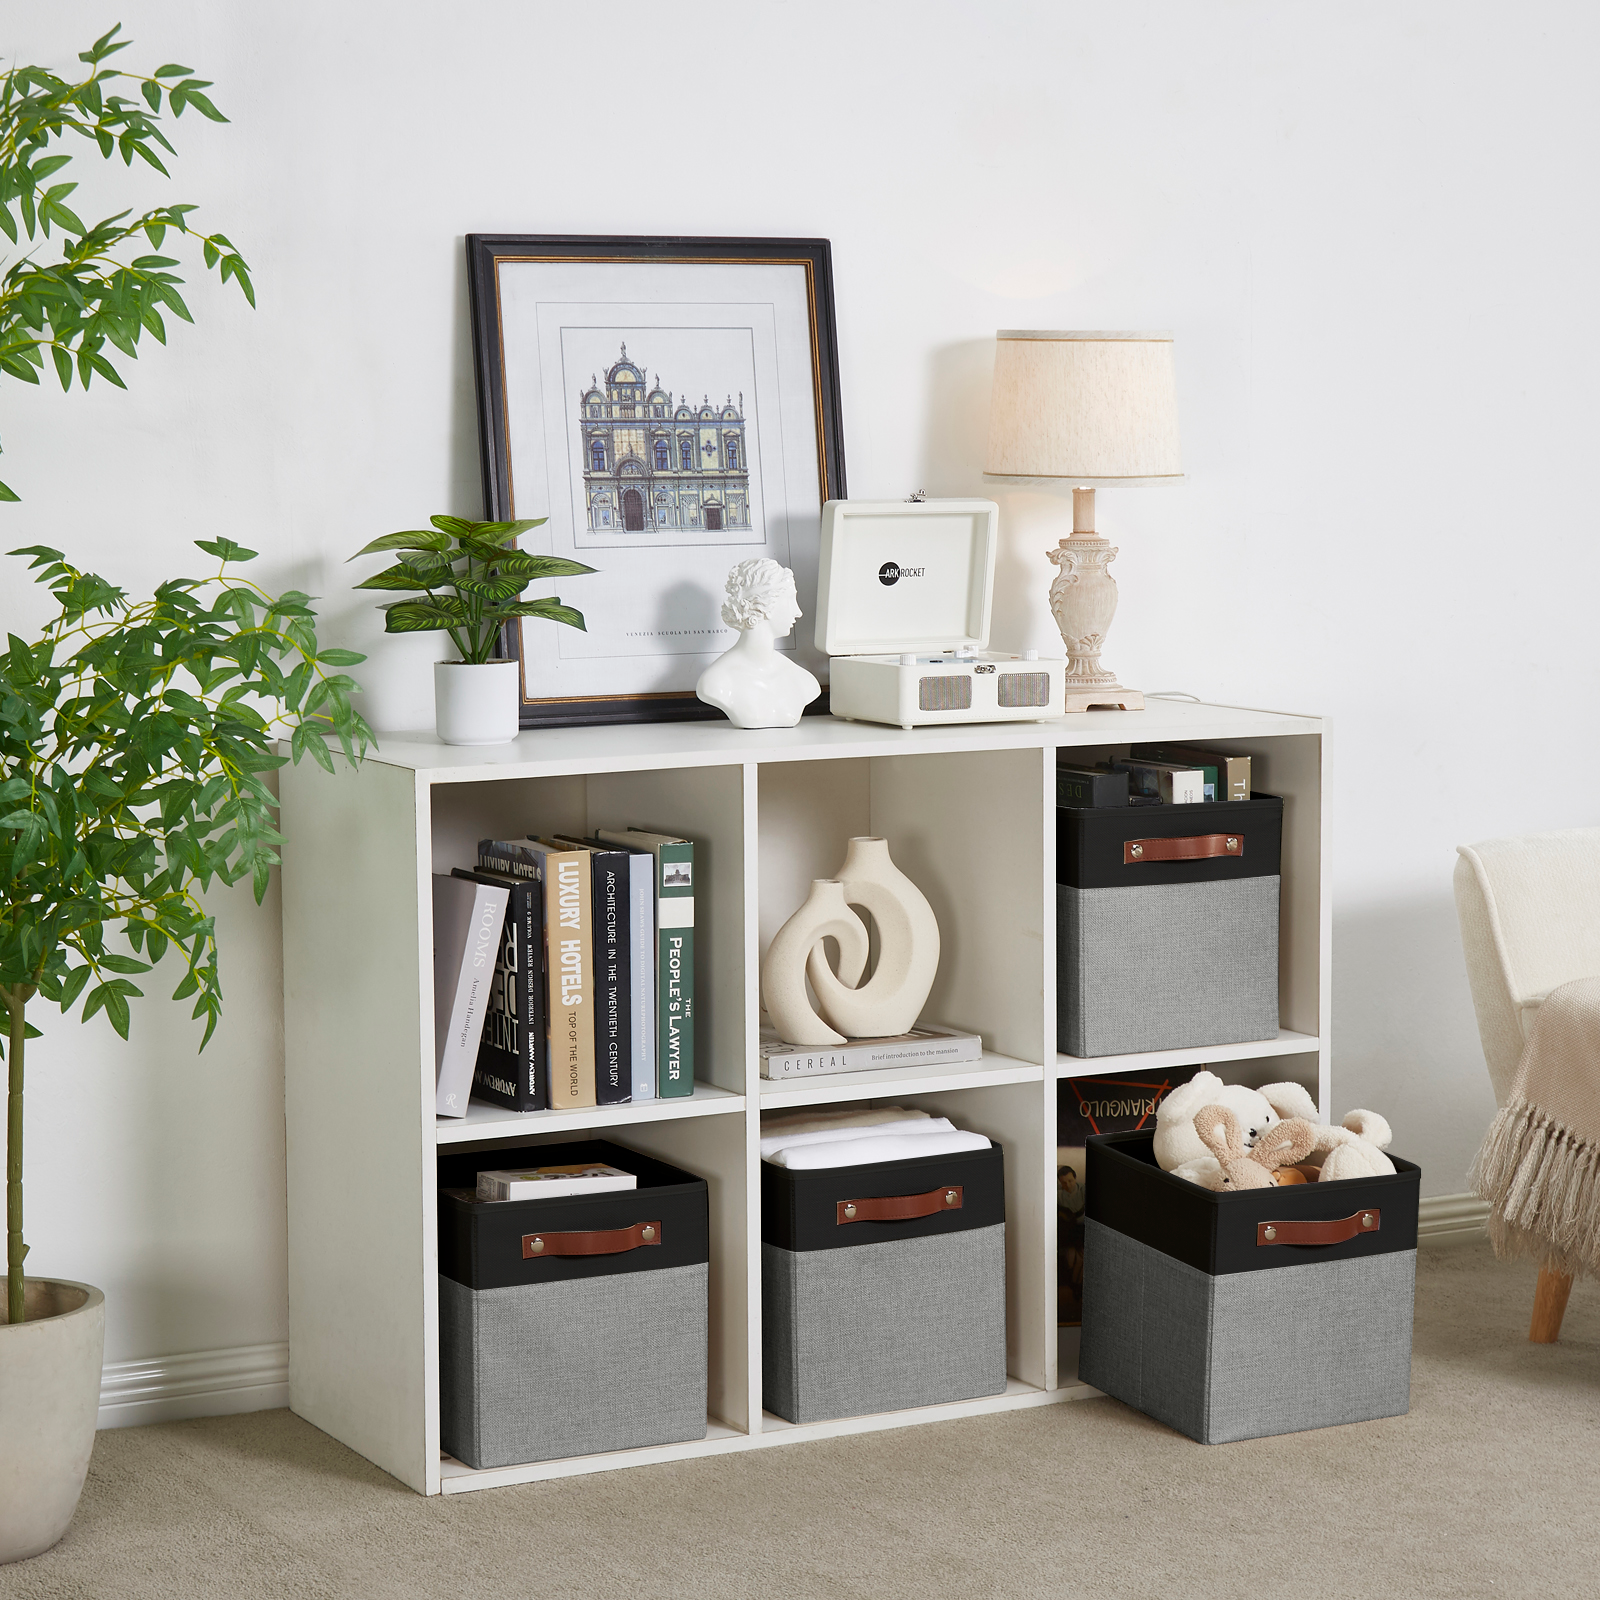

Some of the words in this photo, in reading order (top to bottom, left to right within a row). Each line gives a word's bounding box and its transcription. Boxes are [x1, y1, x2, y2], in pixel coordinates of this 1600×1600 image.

[558, 861, 581, 930] LUXURY
[606, 870, 617, 944] ARCHITECTURE
[473, 902, 497, 968] ROOMS
[560, 939, 583, 1007] HOTELS
[607, 949, 617, 960] IN
[608, 964, 617, 982] THE
[640, 950, 646, 960] TO
[469, 977, 480, 1006] Amelia
[669, 937, 683, 1012] PEOPLE'S
[461, 1006, 474, 1048] Handegan
[568, 1011, 577, 1029] TOP
[608, 986, 618, 1038] TWENTIETH
[568, 1030, 577, 1042] OF
[569, 1045, 578, 1062] THE
[669, 1015, 682, 1081] LAWYER
[608, 1042, 619, 1088] CENTURY
[784, 1055, 847, 1072] CEREAL
[871, 1053, 885, 1061] Brief
[885, 1051, 919, 1060] introduction
[936, 1047, 959, 1055] mansion
[569, 1063, 579, 1097] WORLD
